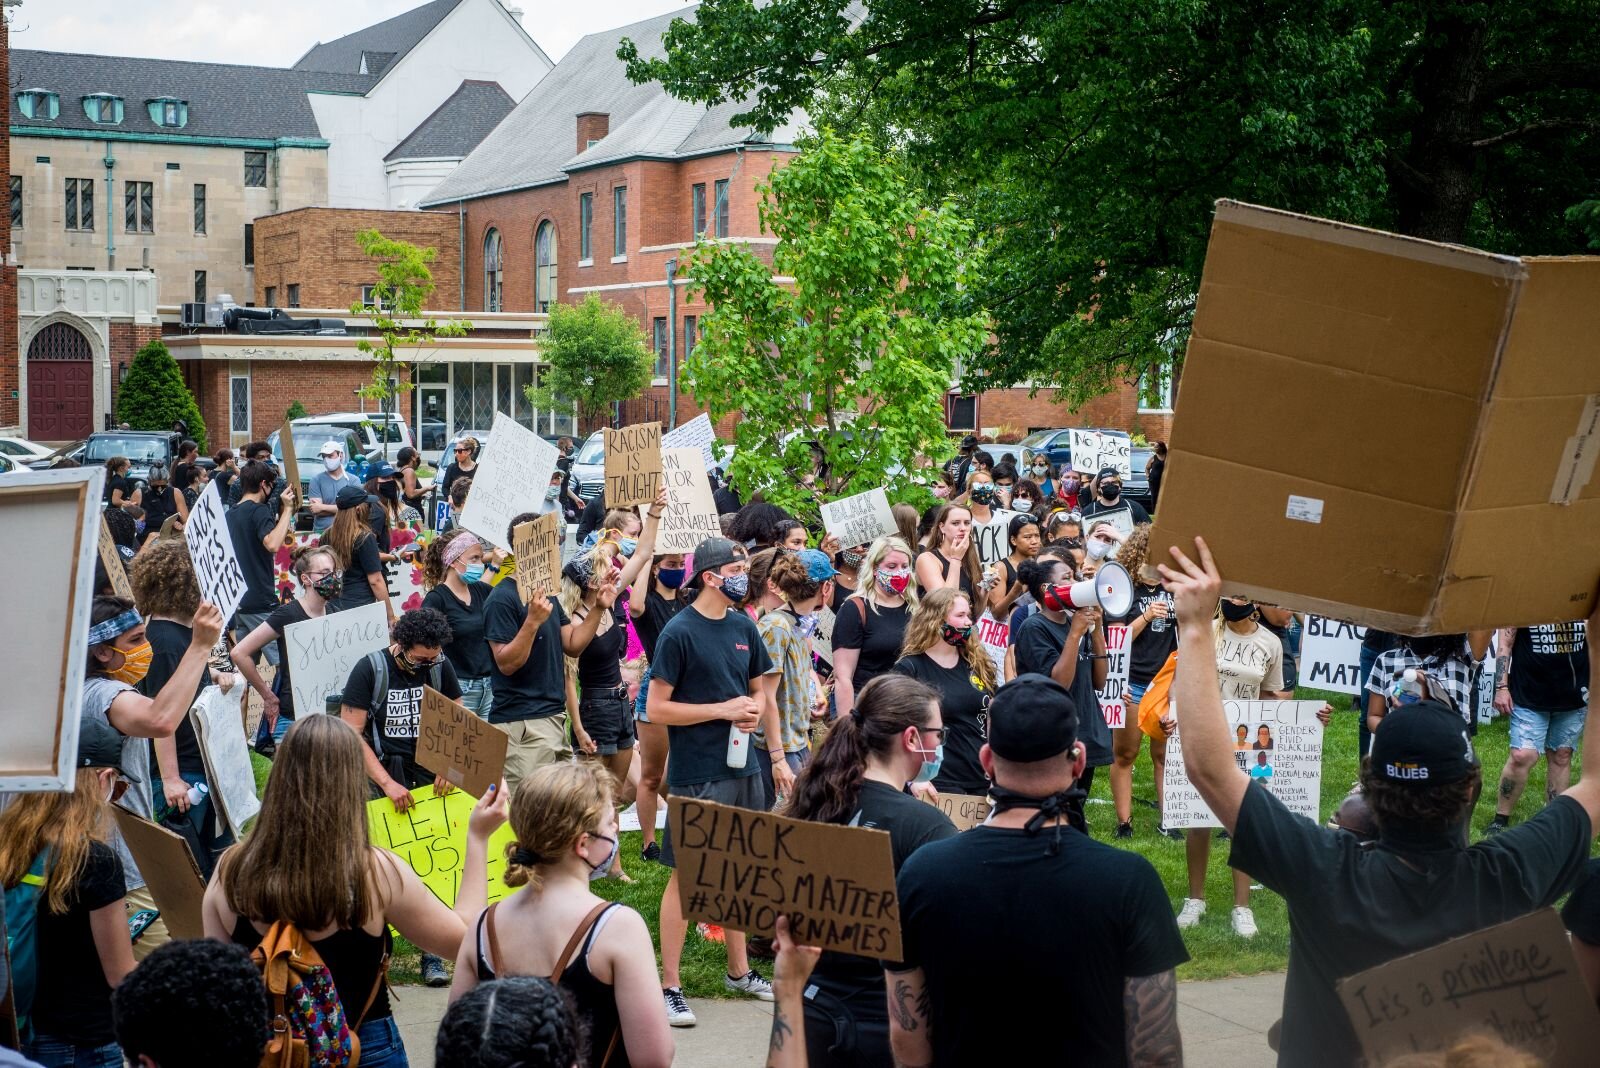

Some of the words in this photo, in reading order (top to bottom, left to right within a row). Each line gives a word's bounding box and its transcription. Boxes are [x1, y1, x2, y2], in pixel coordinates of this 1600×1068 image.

[609, 427, 659, 456] RACISM
[1074, 431, 1092, 447] No
[627, 452, 641, 472] IS
[1074, 452, 1093, 469] No
[609, 471, 661, 504] TAUGHT
[668, 489, 680, 503] IS
[657, 513, 720, 531] ASONABLE
[666, 502, 691, 517] NOT
[829, 492, 876, 524] BLACK
[530, 519, 544, 537] MY
[516, 528, 558, 561] HUMANITY
[972, 525, 1002, 563] ACK
[1104, 627, 1128, 650] ITY
[450, 704, 484, 737] WILL
[424, 726, 484, 775] SILENT
[437, 719, 457, 740] NOT
[462, 732, 477, 753] BE
[1386, 763, 1429, 779] BLUES
[679, 801, 806, 865] BLACK
[408, 837, 460, 878] US
[696, 852, 786, 904] LIVES
[793, 872, 896, 921] MATTER
